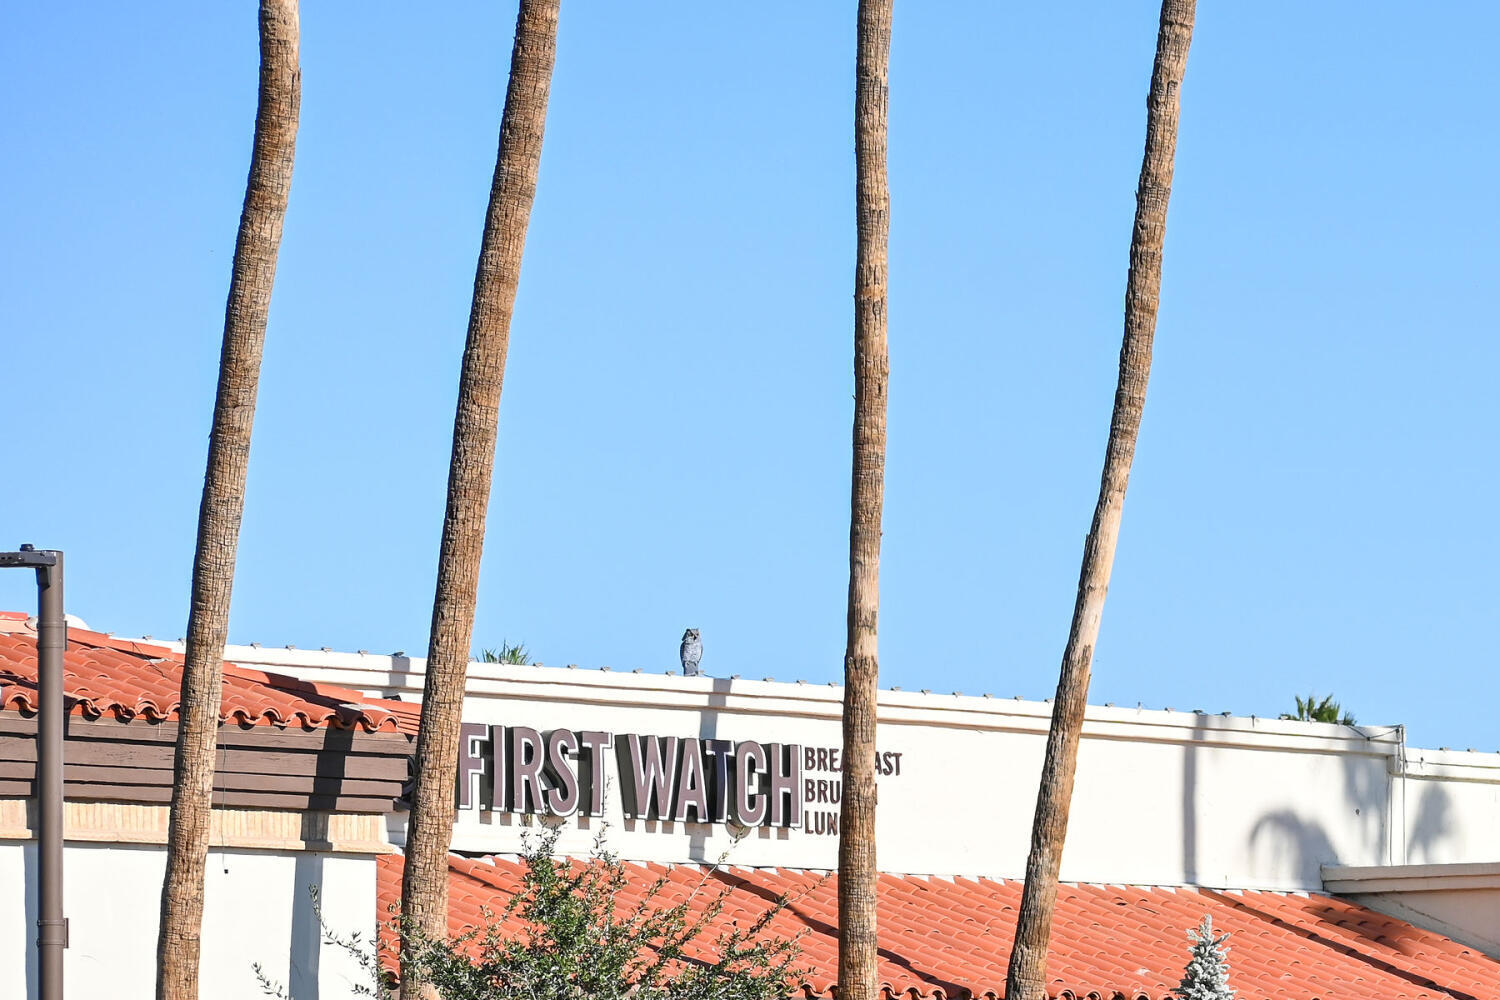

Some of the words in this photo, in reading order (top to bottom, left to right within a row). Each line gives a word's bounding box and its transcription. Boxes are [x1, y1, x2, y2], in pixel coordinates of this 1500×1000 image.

[456, 723, 612, 817] FIRST
[616, 733, 803, 828] WATCH
[805, 747, 902, 776] BREAST
[805, 810, 840, 836] LUN
